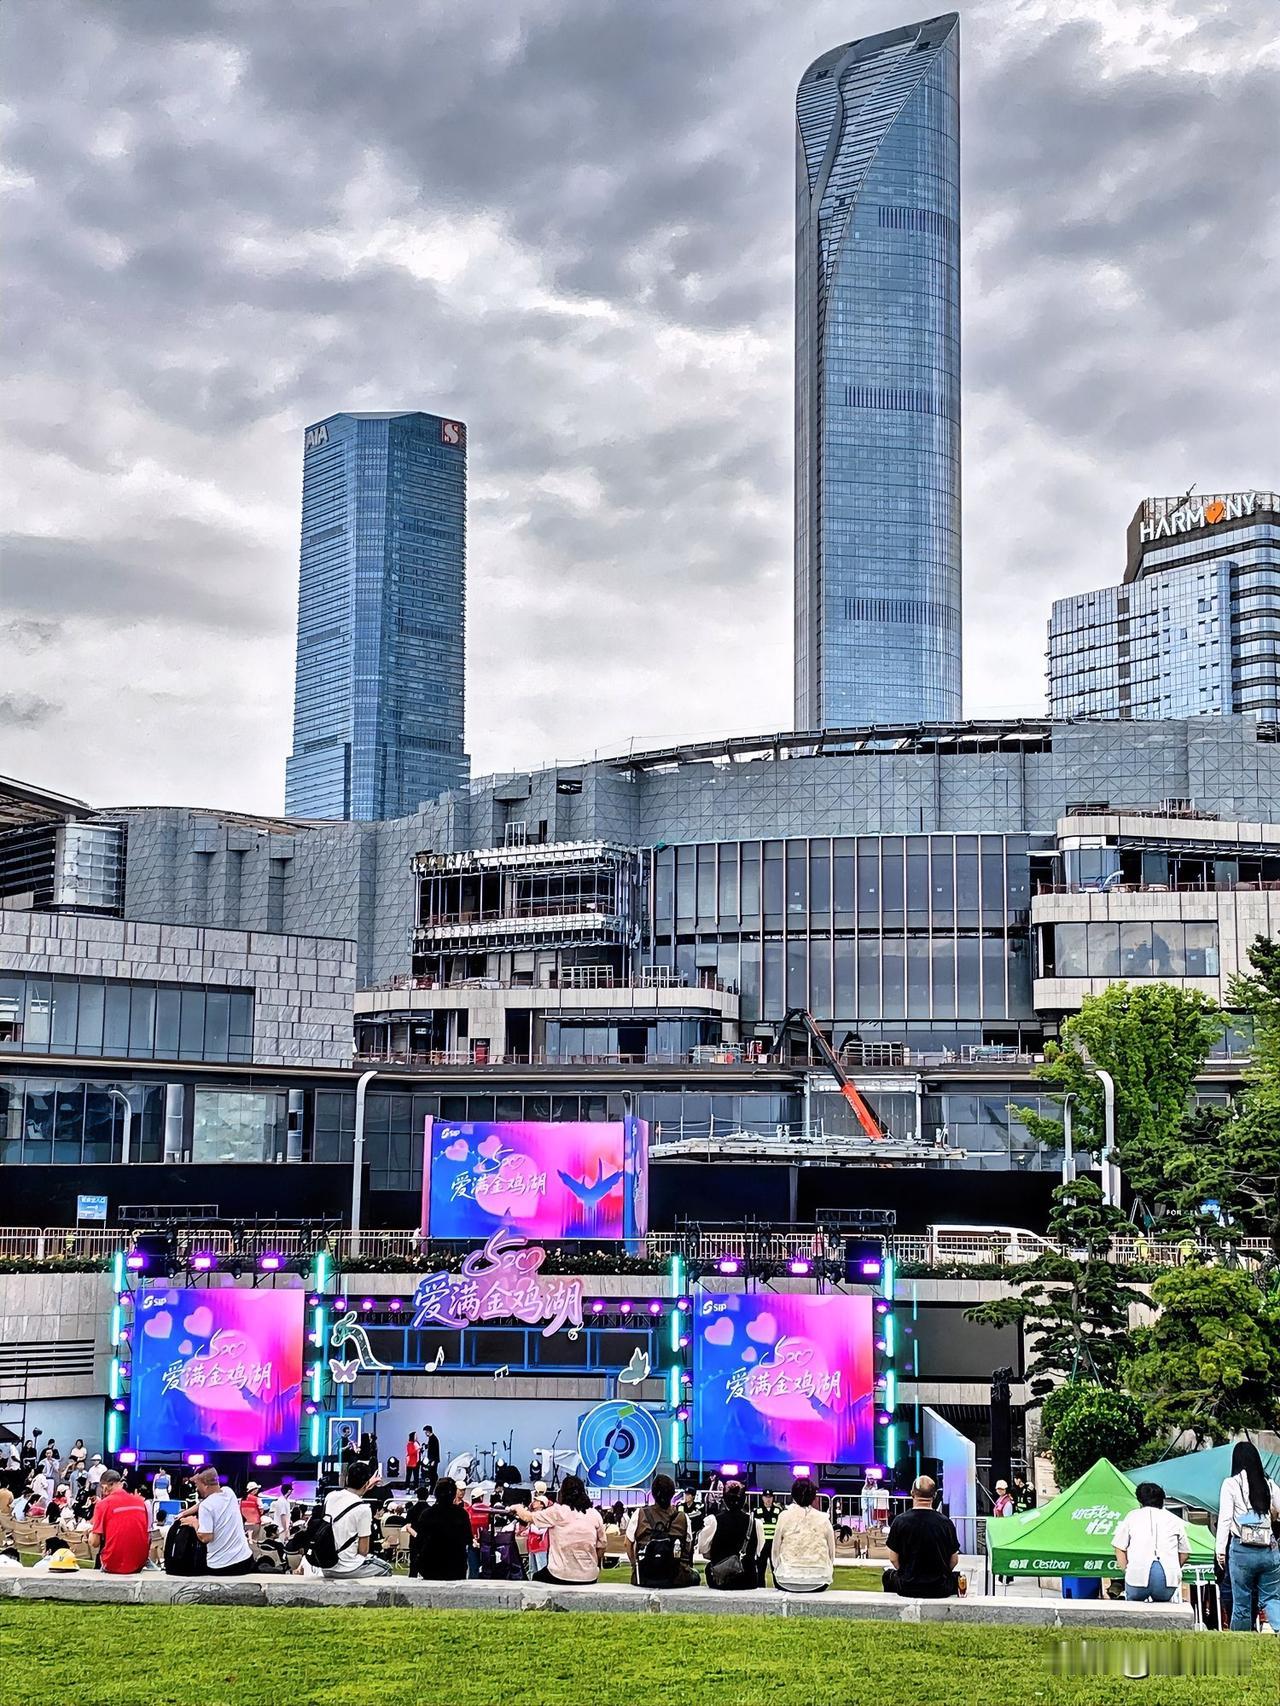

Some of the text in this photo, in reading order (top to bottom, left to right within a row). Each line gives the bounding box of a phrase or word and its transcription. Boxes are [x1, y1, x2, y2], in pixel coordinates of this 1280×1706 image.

[1140, 492, 1256, 543] HARMONY
[450, 1171, 547, 1202] 爱满金鸡湖
[412, 1272, 583, 1337] 爱满金鸡湖
[713, 1303, 727, 1312] SIP
[161, 1360, 272, 1397] 爱满金鸡湖
[725, 1367, 842, 1405] 爱满金鸡湖
